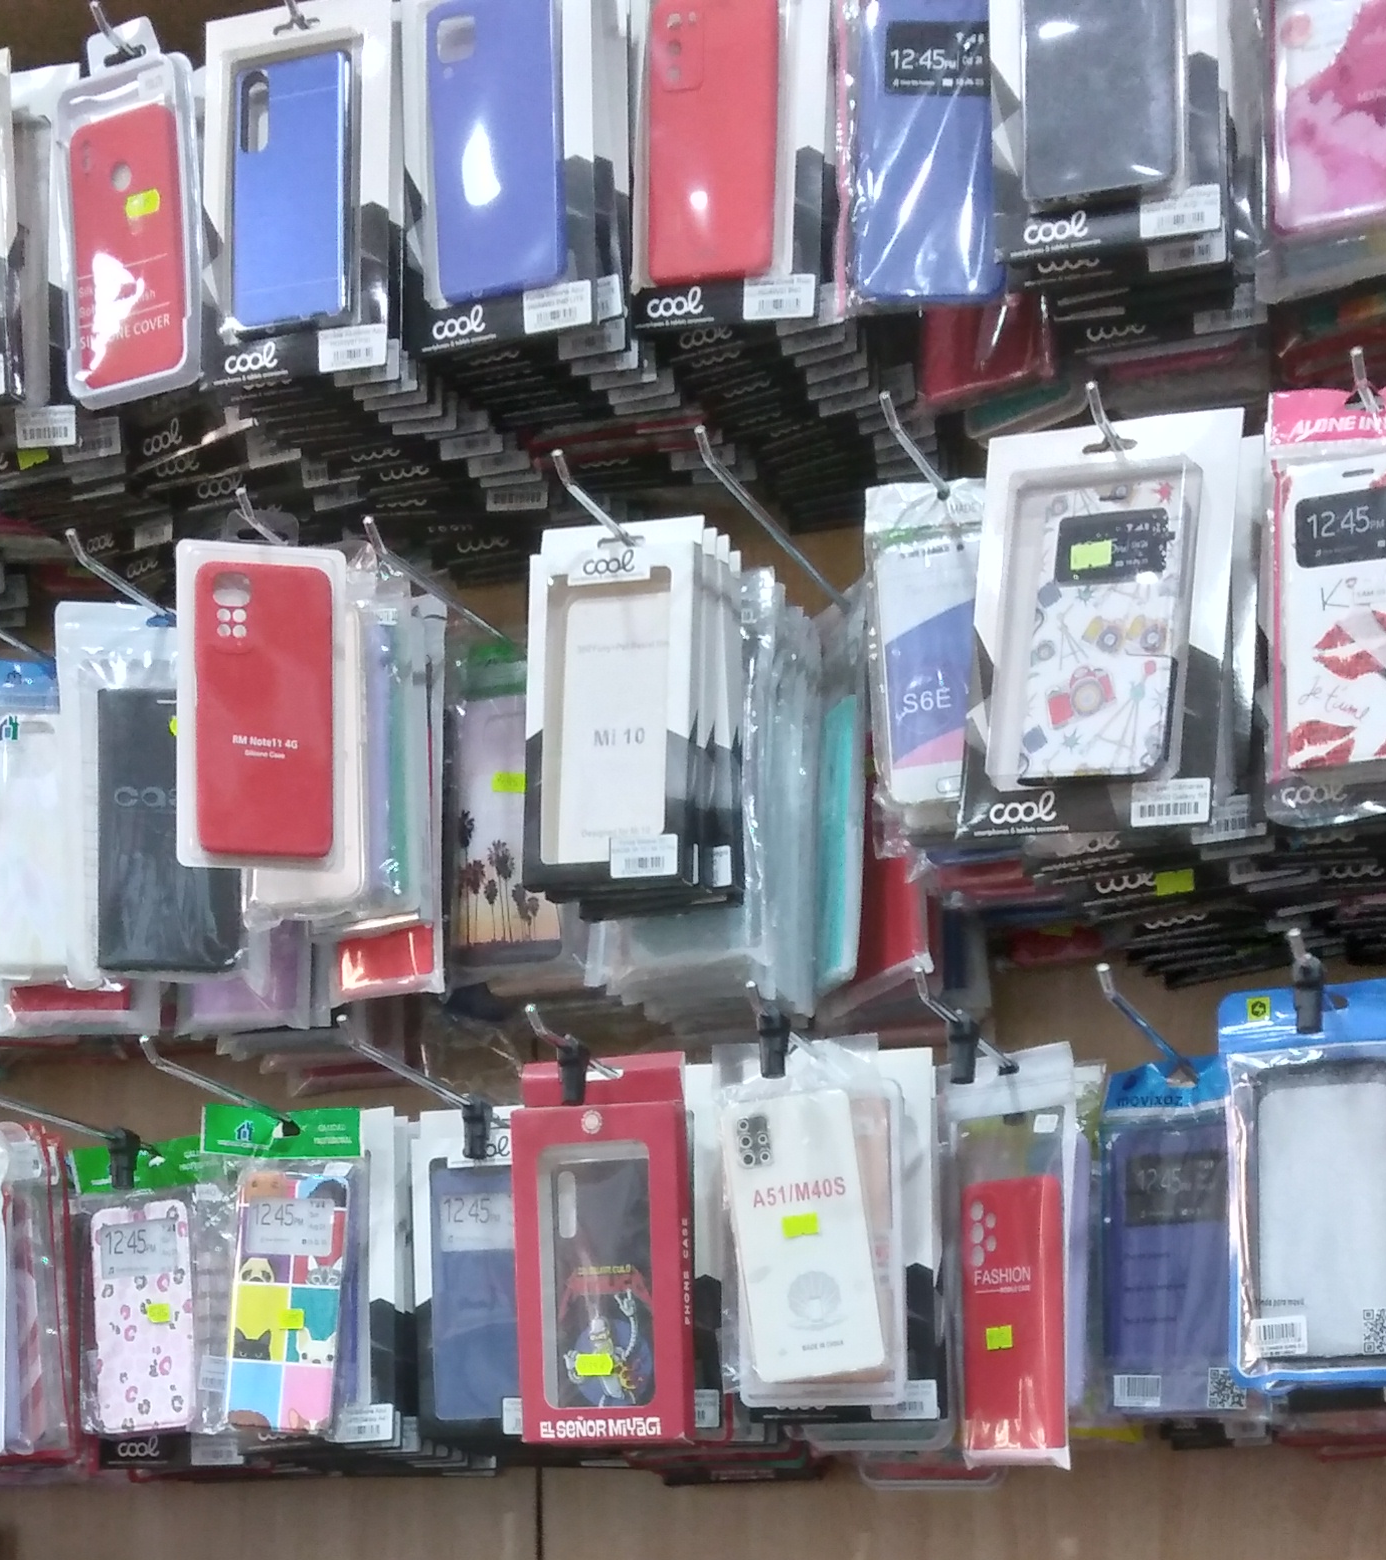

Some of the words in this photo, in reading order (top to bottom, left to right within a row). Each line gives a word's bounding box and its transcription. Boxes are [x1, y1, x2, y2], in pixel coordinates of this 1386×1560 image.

[1023, 211, 1088, 244] cool
[647, 285, 704, 318] cool
[432, 304, 485, 341] cool
[224, 340, 279, 375] cool
[582, 548, 635, 575] cool
[902, 687, 951, 714] S6E
[594, 726, 616, 746] Mi
[624, 727, 646, 745] 10
[989, 790, 1057, 824] cool
[753, 1177, 847, 1209] A51/M40S
[974, 1264, 1031, 1286] FASHION
[118, 1436, 160, 1458] cool
